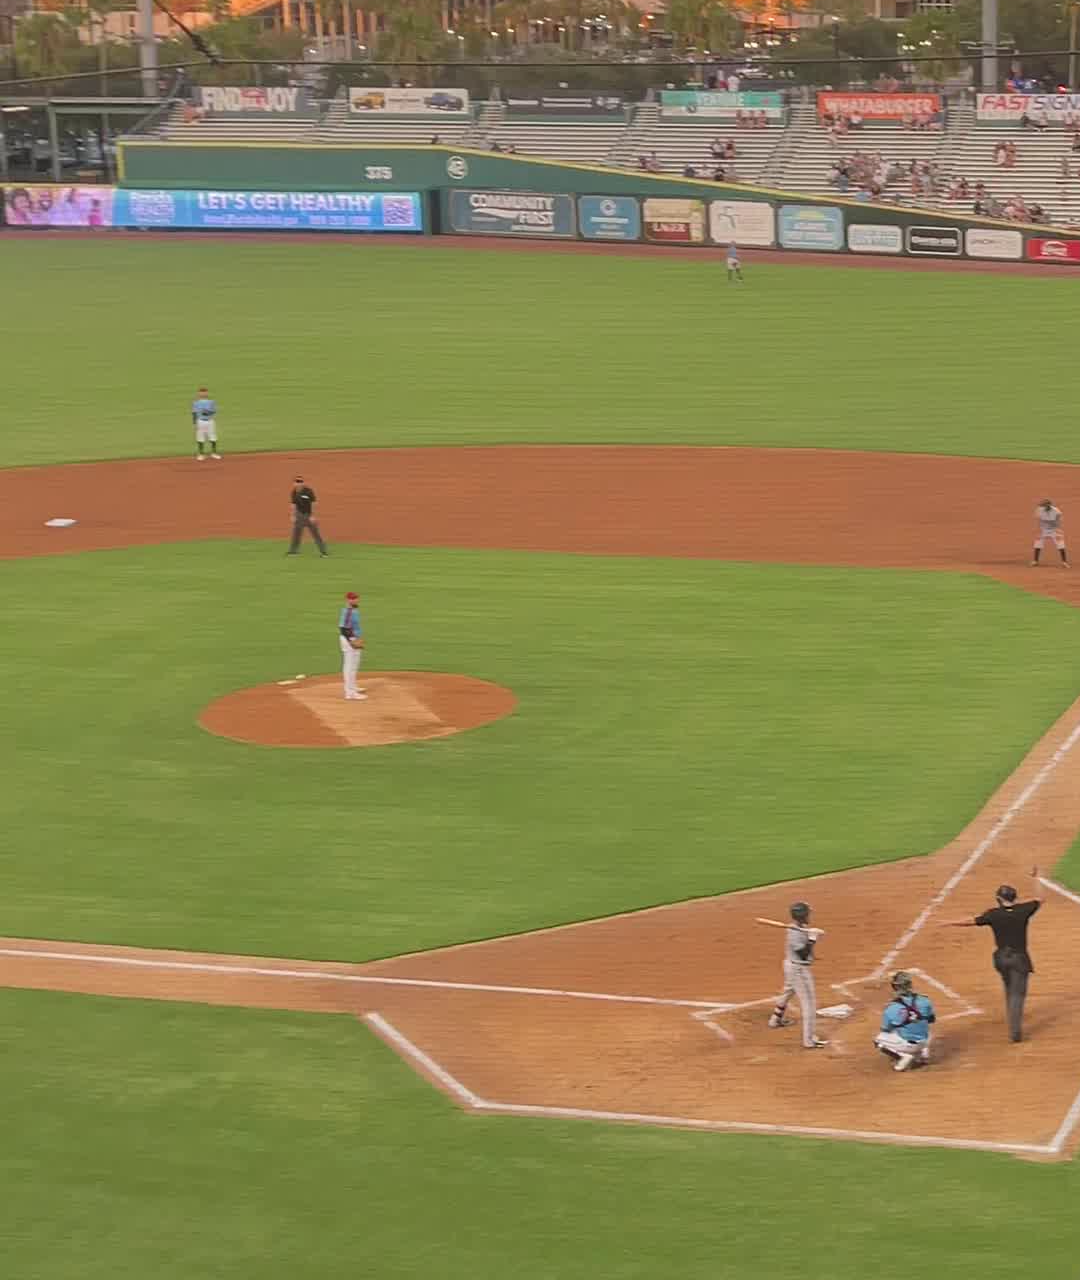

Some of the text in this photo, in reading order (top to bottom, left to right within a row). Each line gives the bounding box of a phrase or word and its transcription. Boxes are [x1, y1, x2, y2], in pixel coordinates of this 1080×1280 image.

[823, 98, 935, 115] WHATABURGER
[197, 192, 247, 211] LET'S
[250, 193, 289, 211] GET
[290, 194, 375, 212] HEALTHY
[469, 194, 554, 211] COMMUNITY
[518, 211, 554, 225] FIRST
